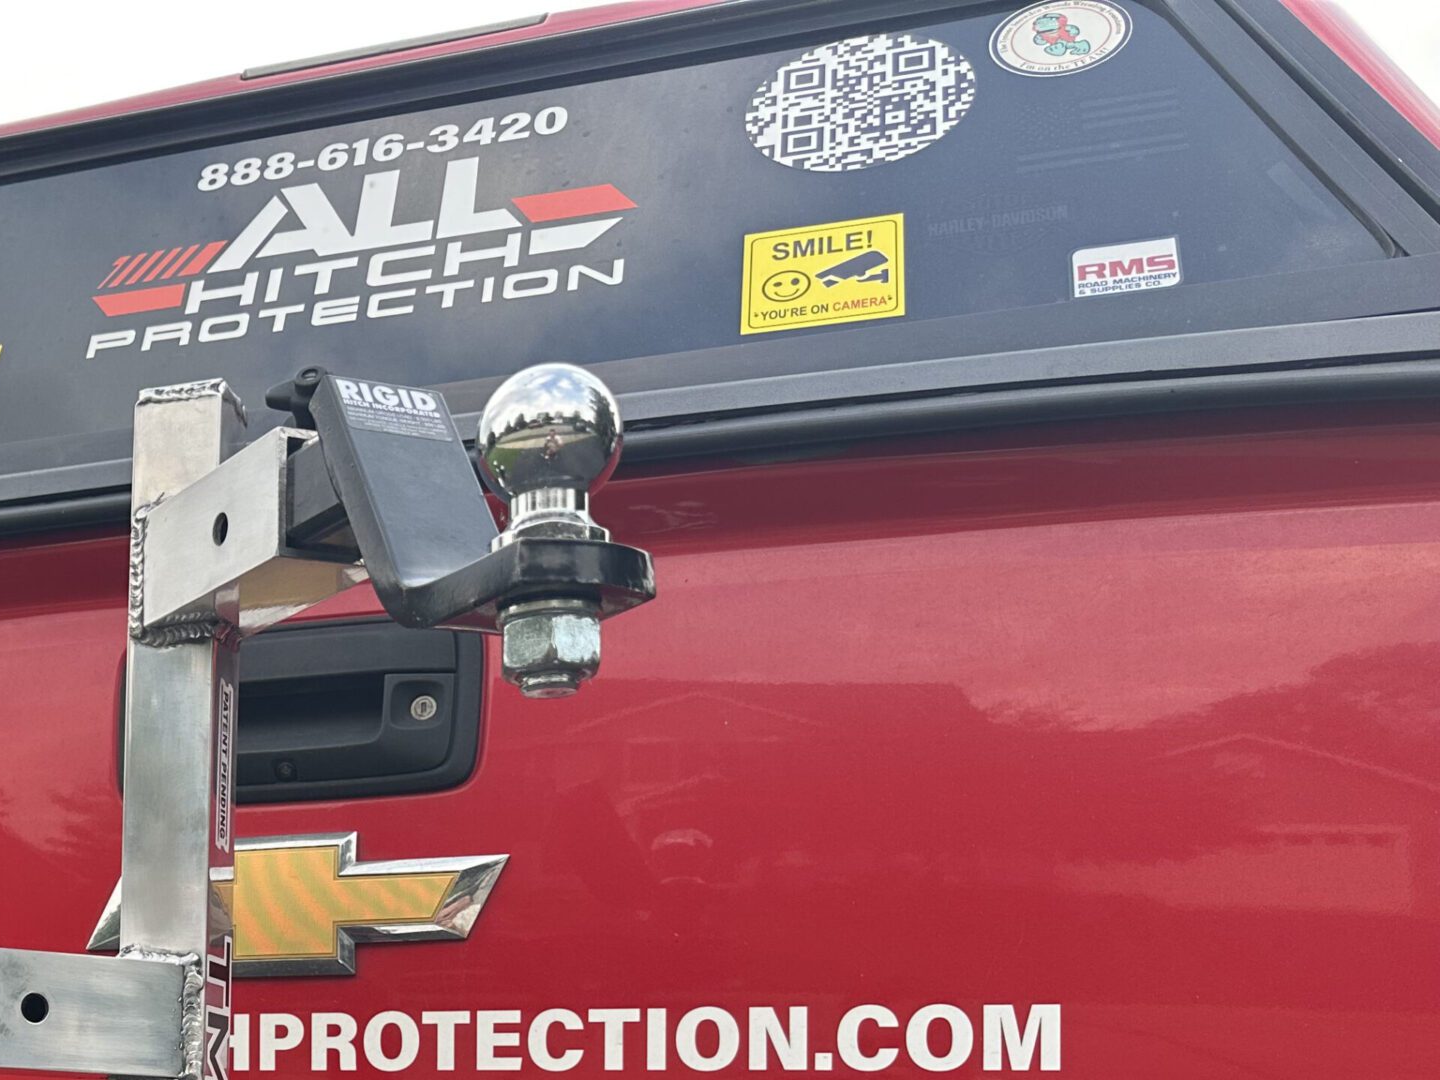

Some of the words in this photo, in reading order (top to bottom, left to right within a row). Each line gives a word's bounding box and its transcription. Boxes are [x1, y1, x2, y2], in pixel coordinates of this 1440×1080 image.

[197, 106, 568, 191] 888-616-3420
[207, 156, 522, 273] ALL
[772, 230, 873, 261] SMILE!
[184, 232, 521, 315] HITCH
[1077, 254, 1176, 281] RMS
[1078, 280, 1108, 289] ROAD
[1112, 272, 1178, 284] MACHINERY
[1090, 283, 1142, 293] SUPPLIES
[85, 259, 625, 359] PROTECTION
[811, 303, 829, 314] ON
[335, 378, 437, 411] RIGID
[343, 399, 370, 409] HITCH
[372, 402, 441, 418] INCORPORATED
[221, 691, 230, 758] PATENT
[219, 762, 228, 840] PENDING
